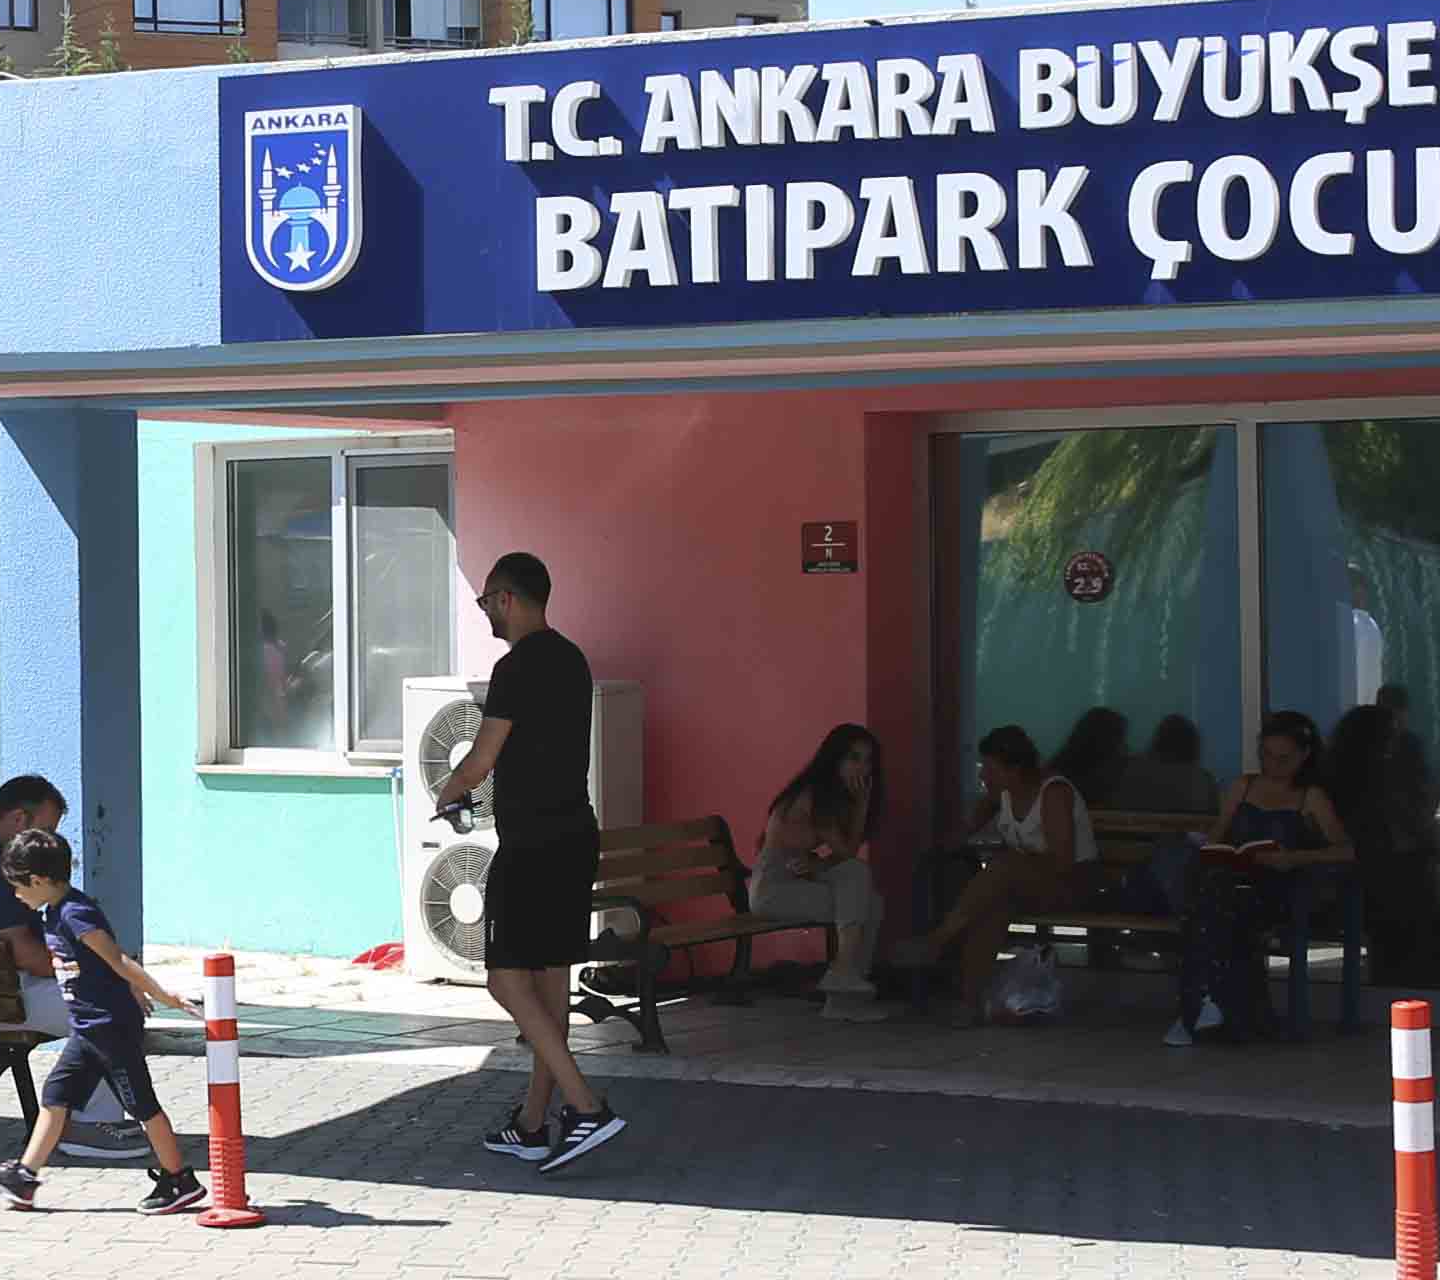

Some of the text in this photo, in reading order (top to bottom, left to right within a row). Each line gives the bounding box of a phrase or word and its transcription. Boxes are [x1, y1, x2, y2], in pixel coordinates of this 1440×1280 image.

[251, 111, 349, 131] ANKARA
[487, 81, 623, 162] T.C.
[639, 53, 996, 154] ANKARA
[535, 165, 1095, 292] BATIPARK
[823, 524, 833, 542] 2
